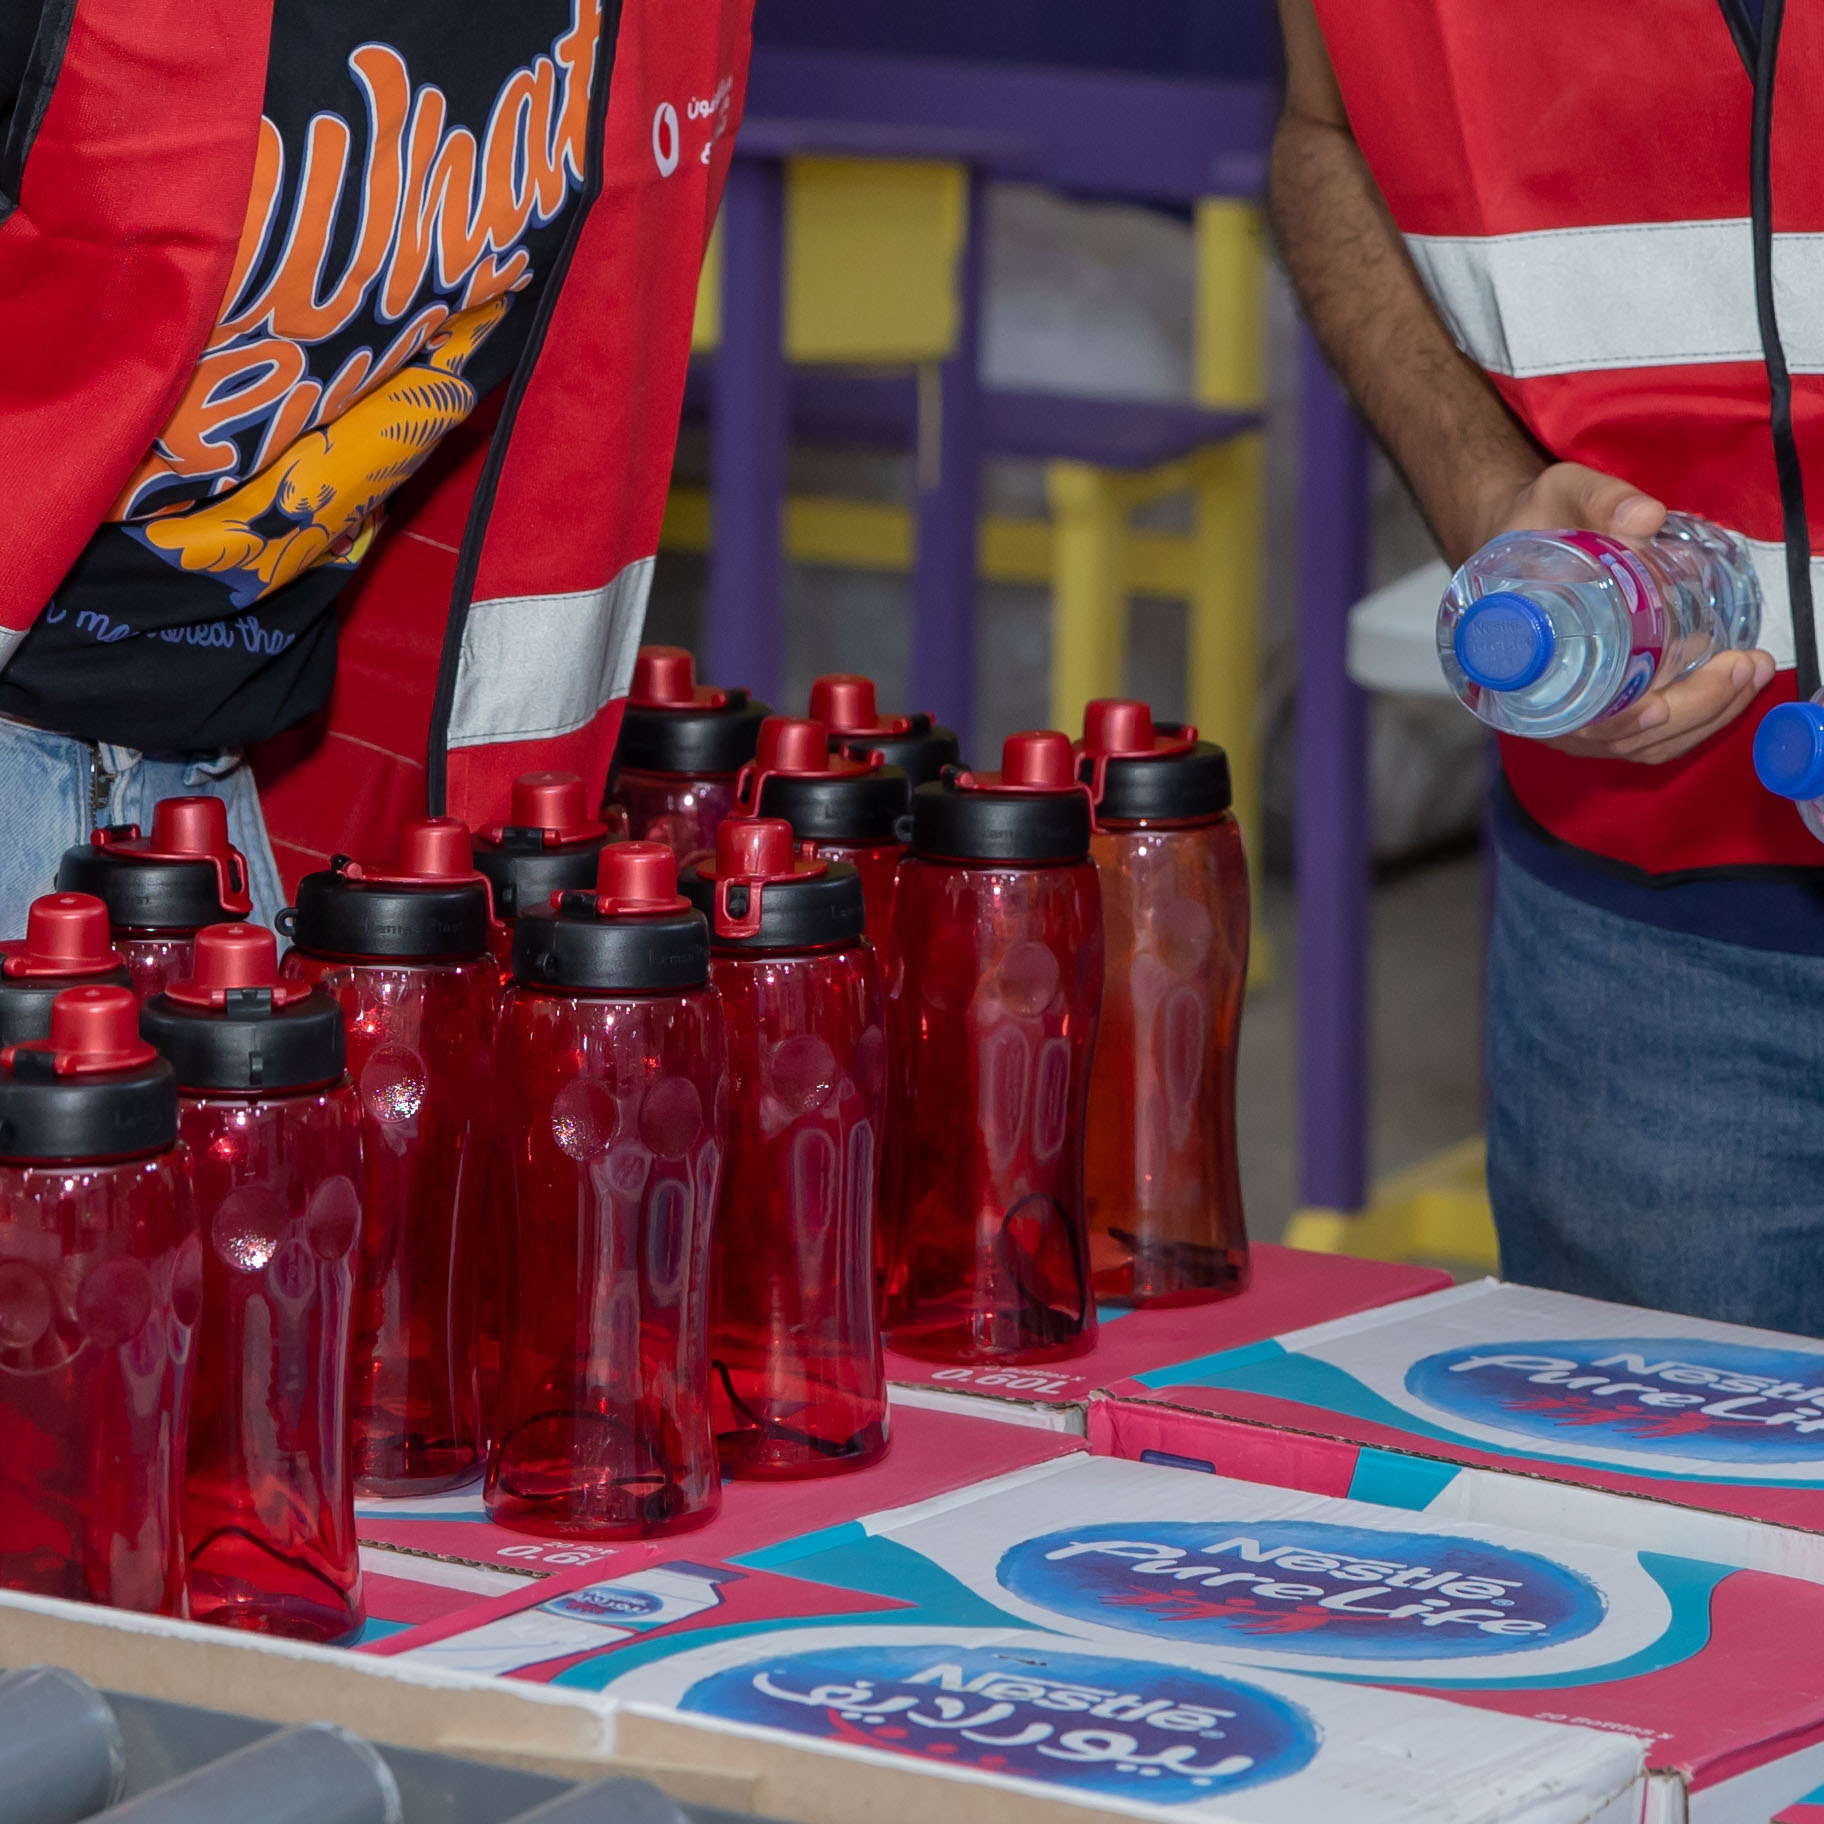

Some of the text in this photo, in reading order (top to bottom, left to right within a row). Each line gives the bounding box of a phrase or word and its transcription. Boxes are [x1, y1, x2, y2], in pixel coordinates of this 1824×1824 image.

[931, 1369, 1068, 1395] 0.60L
[496, 1545, 604, 1566] 0.6
[1202, 1537, 1522, 1601] Nestlé
[903, 1664, 1236, 1731] Nestlé
